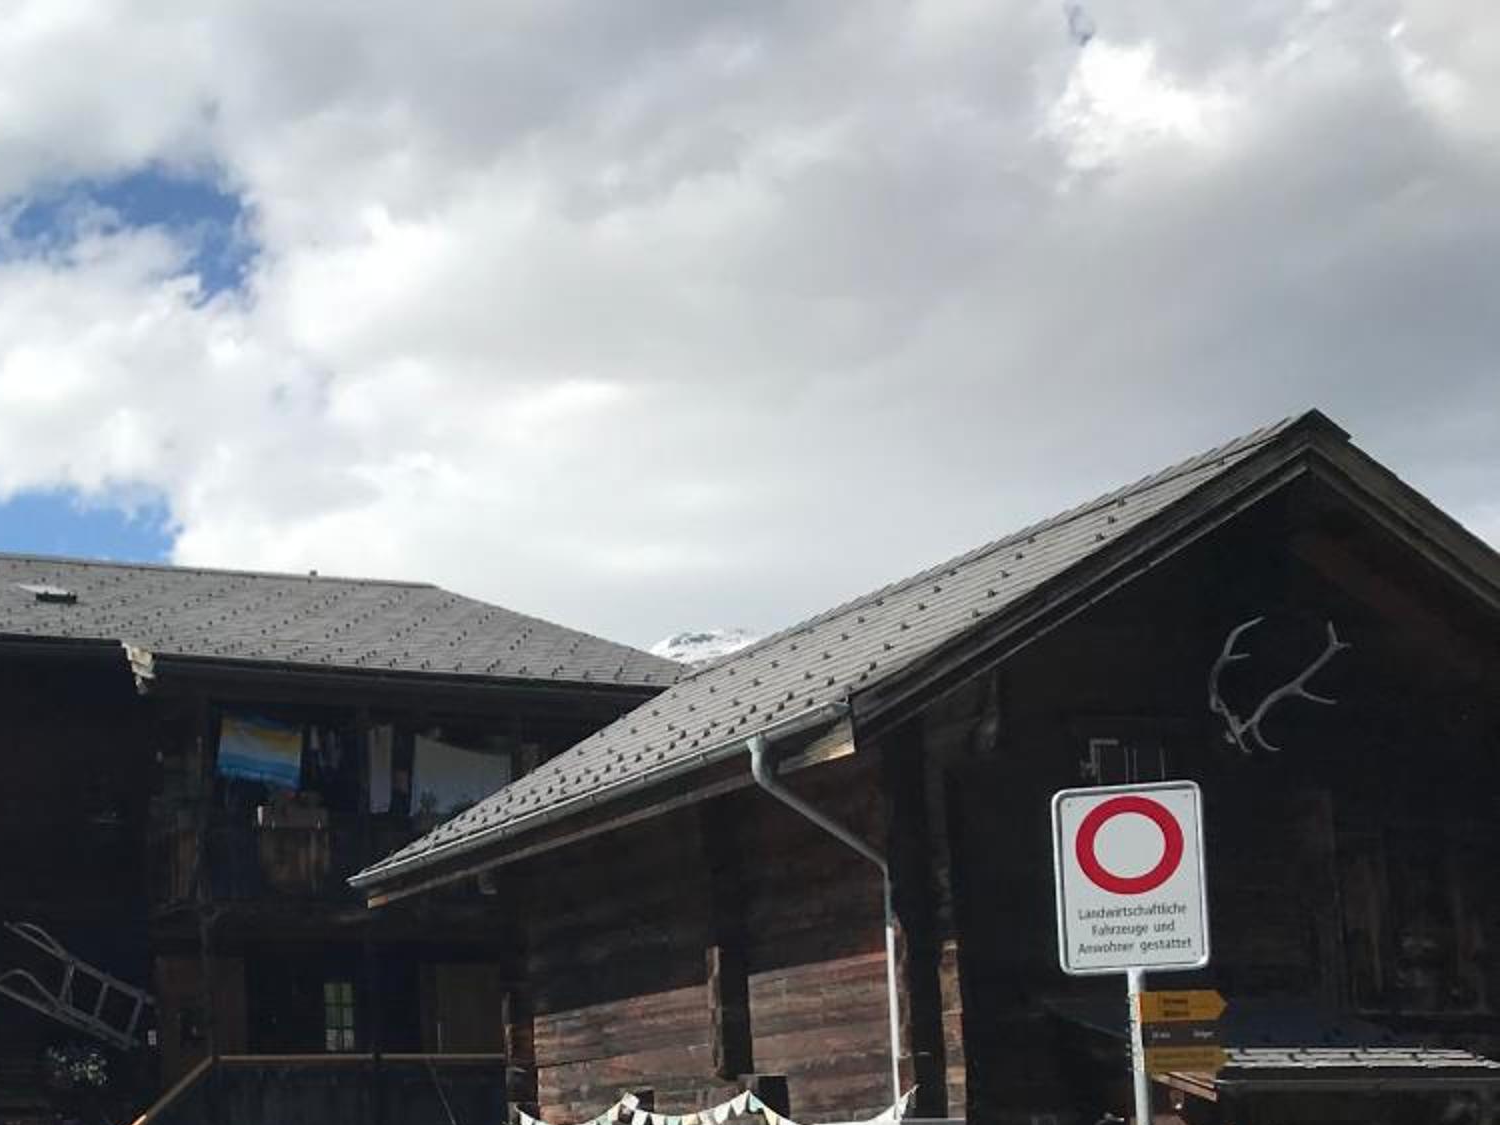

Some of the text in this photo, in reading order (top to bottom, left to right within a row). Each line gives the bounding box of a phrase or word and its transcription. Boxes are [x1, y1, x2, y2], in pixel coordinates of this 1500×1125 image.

[1077, 902, 1187, 920] Landwirtschaftliche
[1091, 920, 1176, 937] Fahrzeuge und
[1077, 937, 1192, 955] Anwohner gestattet
